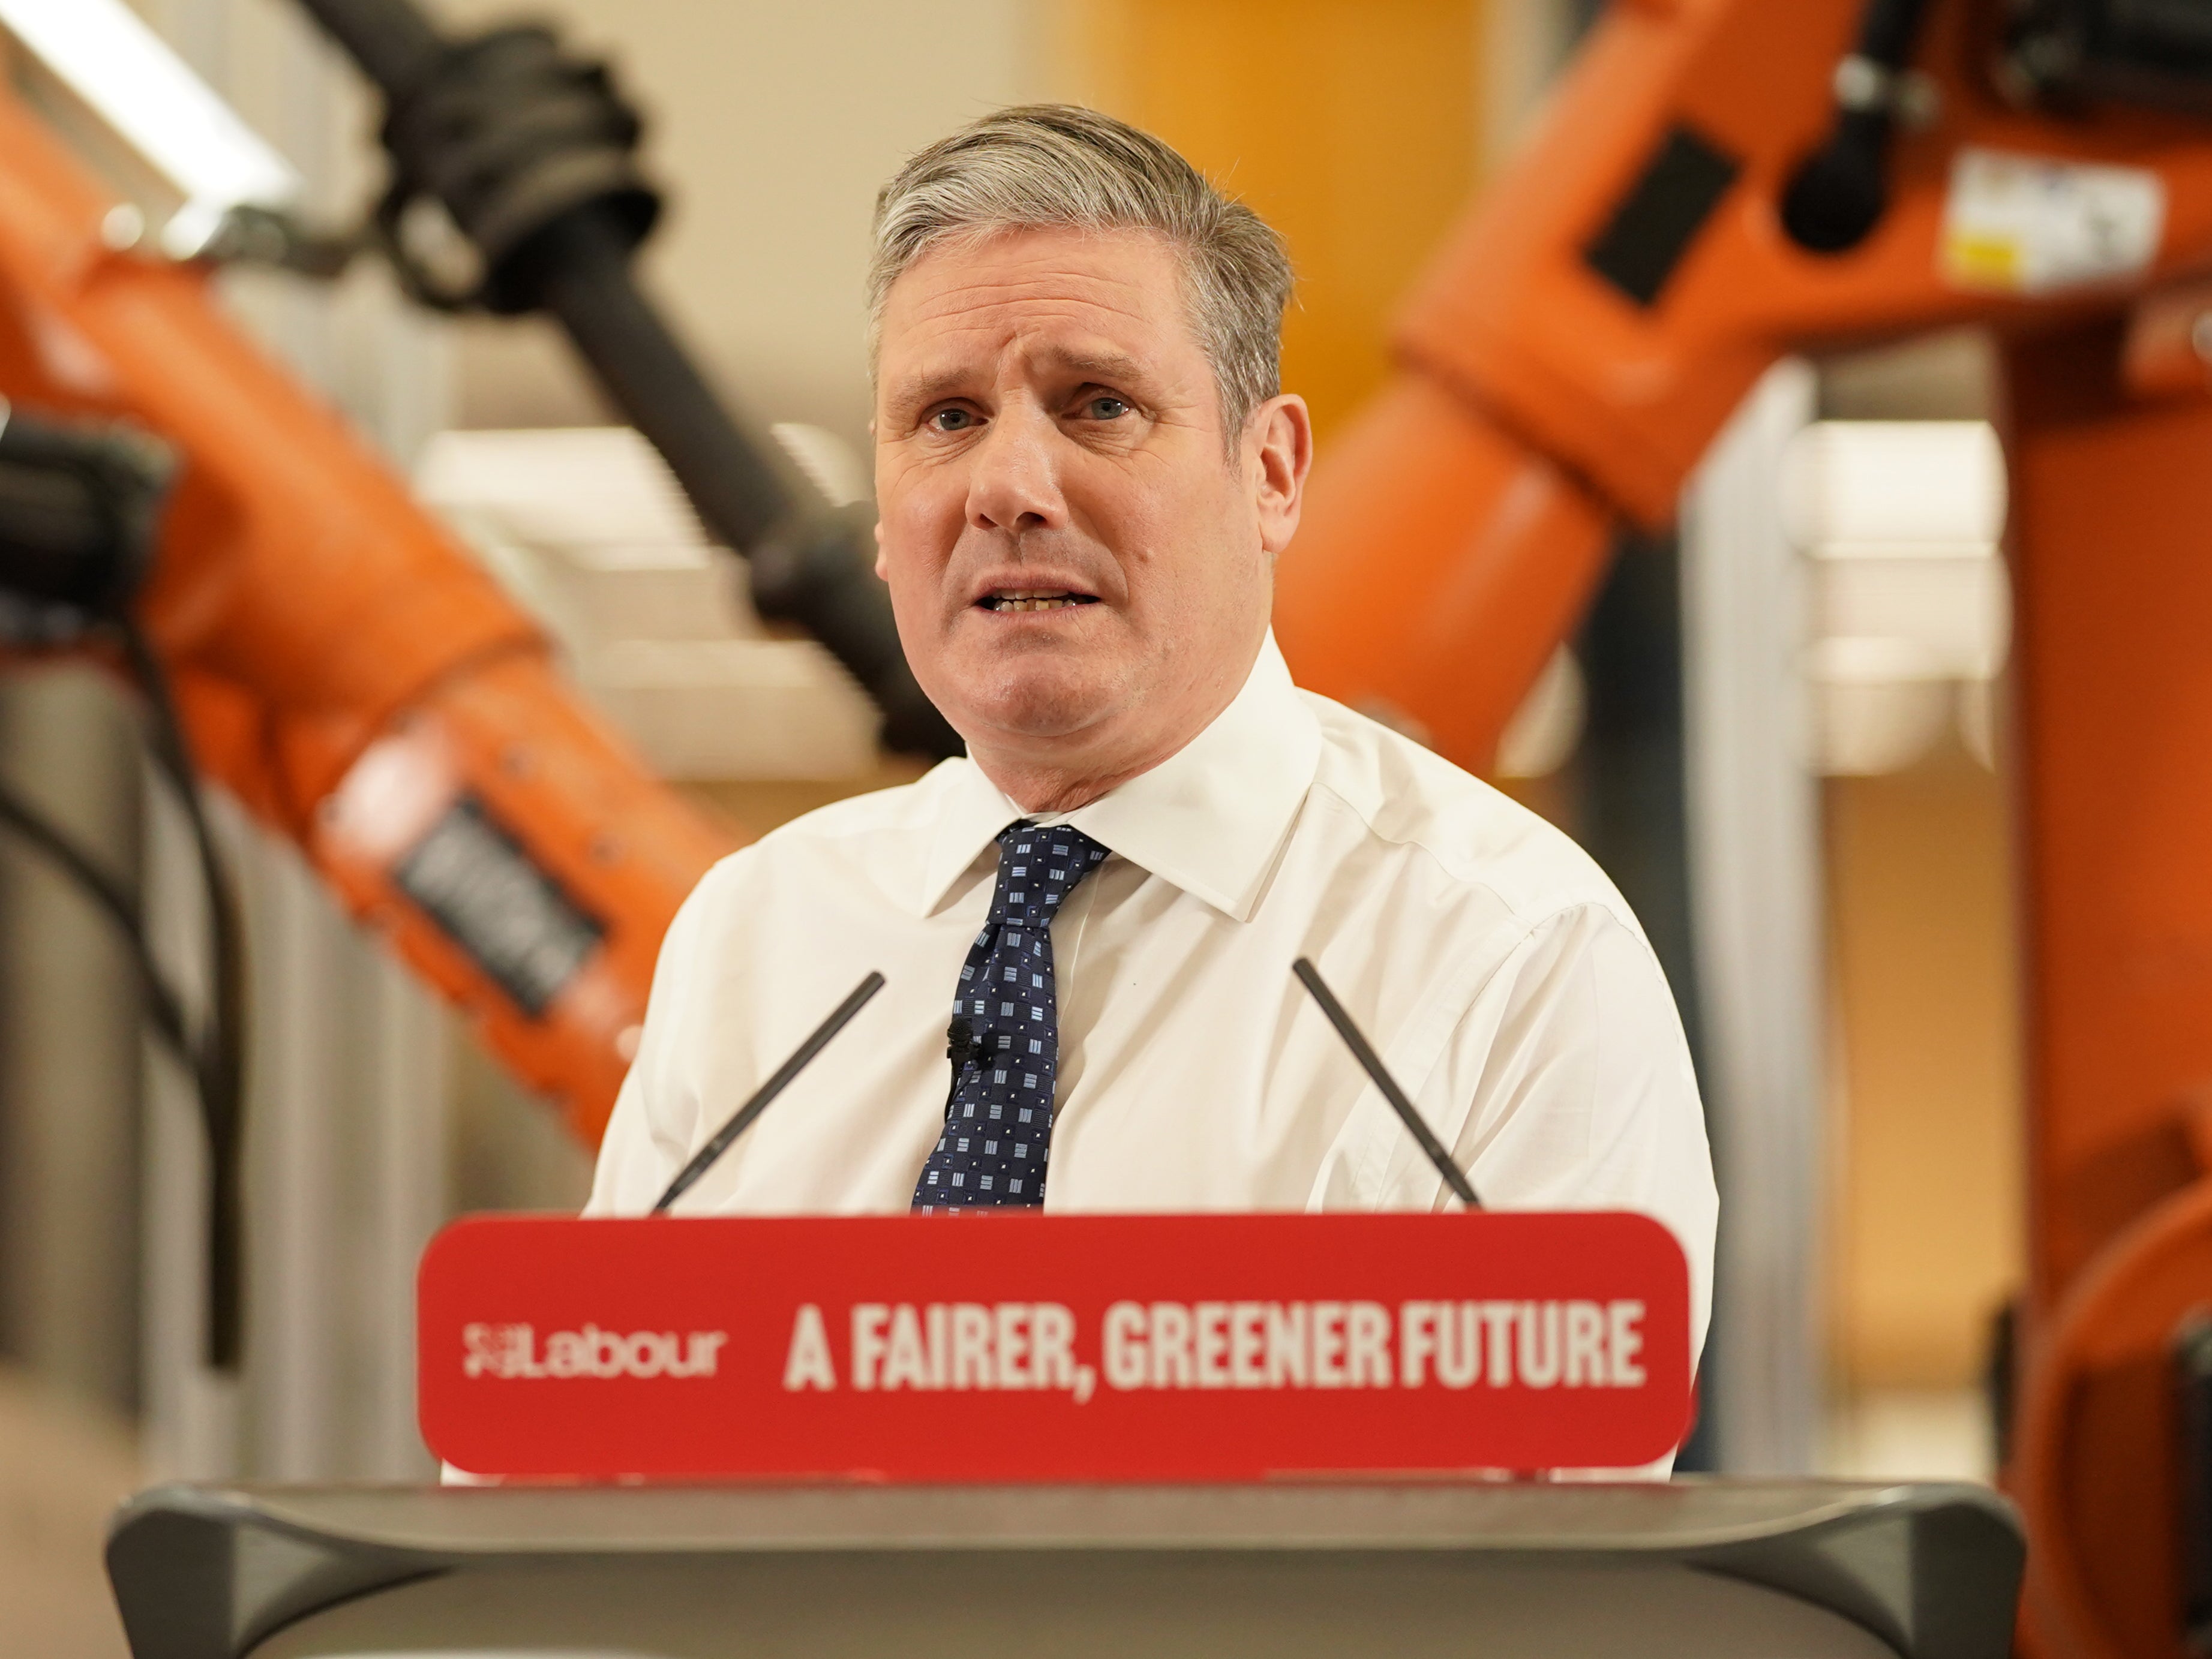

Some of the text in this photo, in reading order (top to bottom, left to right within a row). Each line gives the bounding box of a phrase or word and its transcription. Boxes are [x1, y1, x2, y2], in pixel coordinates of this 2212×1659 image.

[515, 1323, 727, 1379] Labour
[784, 1300, 1646, 1404] A FAIRER, GREENER FUTURE
